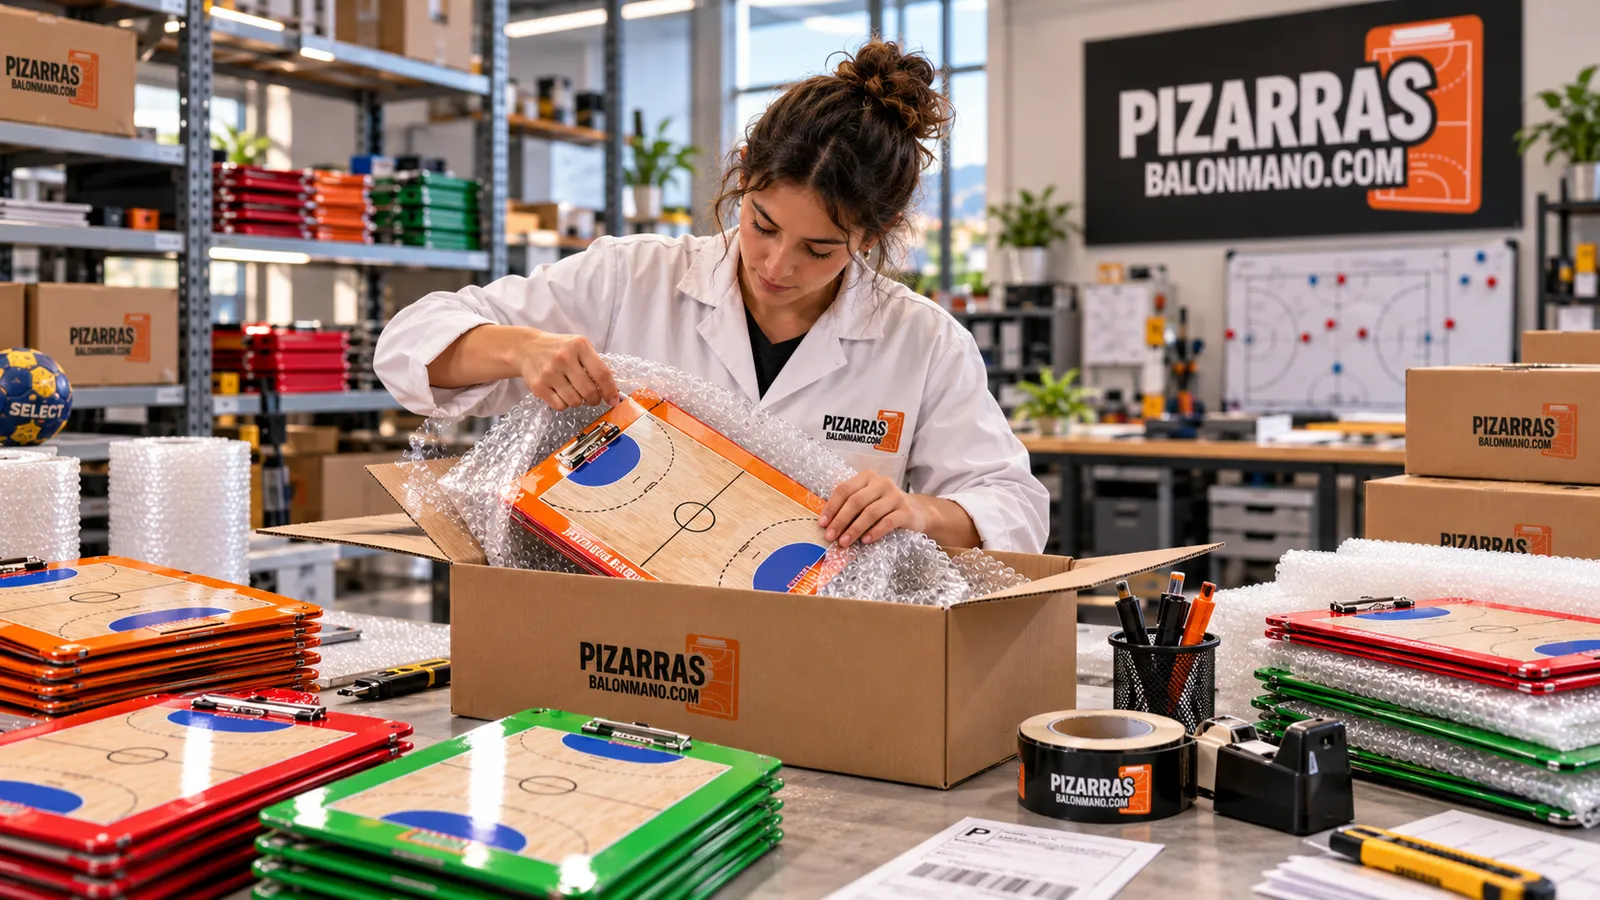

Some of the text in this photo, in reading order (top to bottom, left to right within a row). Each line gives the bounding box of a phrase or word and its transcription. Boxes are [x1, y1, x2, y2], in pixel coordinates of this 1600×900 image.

[5, 55, 80, 86] PIZARRAS
[11, 79, 77, 98] BALONMANO.COM
[1119, 60, 1432, 159] PIZARRAS
[1145, 147, 1404, 198] BALONMANO.COM
[69, 326, 134, 346] PIZARRAS
[9, 402, 65, 419] SELECT
[822, 414, 887, 436] PIZARRAS
[1472, 416, 1555, 438] PIZARRAS
[1478, 437, 1552, 450] BALONMANO.COM
[1440, 532, 1528, 555] PIZARRAS
[580, 641, 706, 687] PIZARRAS
[589, 674, 700, 704] BALONMANO.COM
[1050, 772, 1135, 798] PIZARRAS
[1055, 793, 1129, 809] BALONMANO.COM
[964, 826, 991, 838] P
